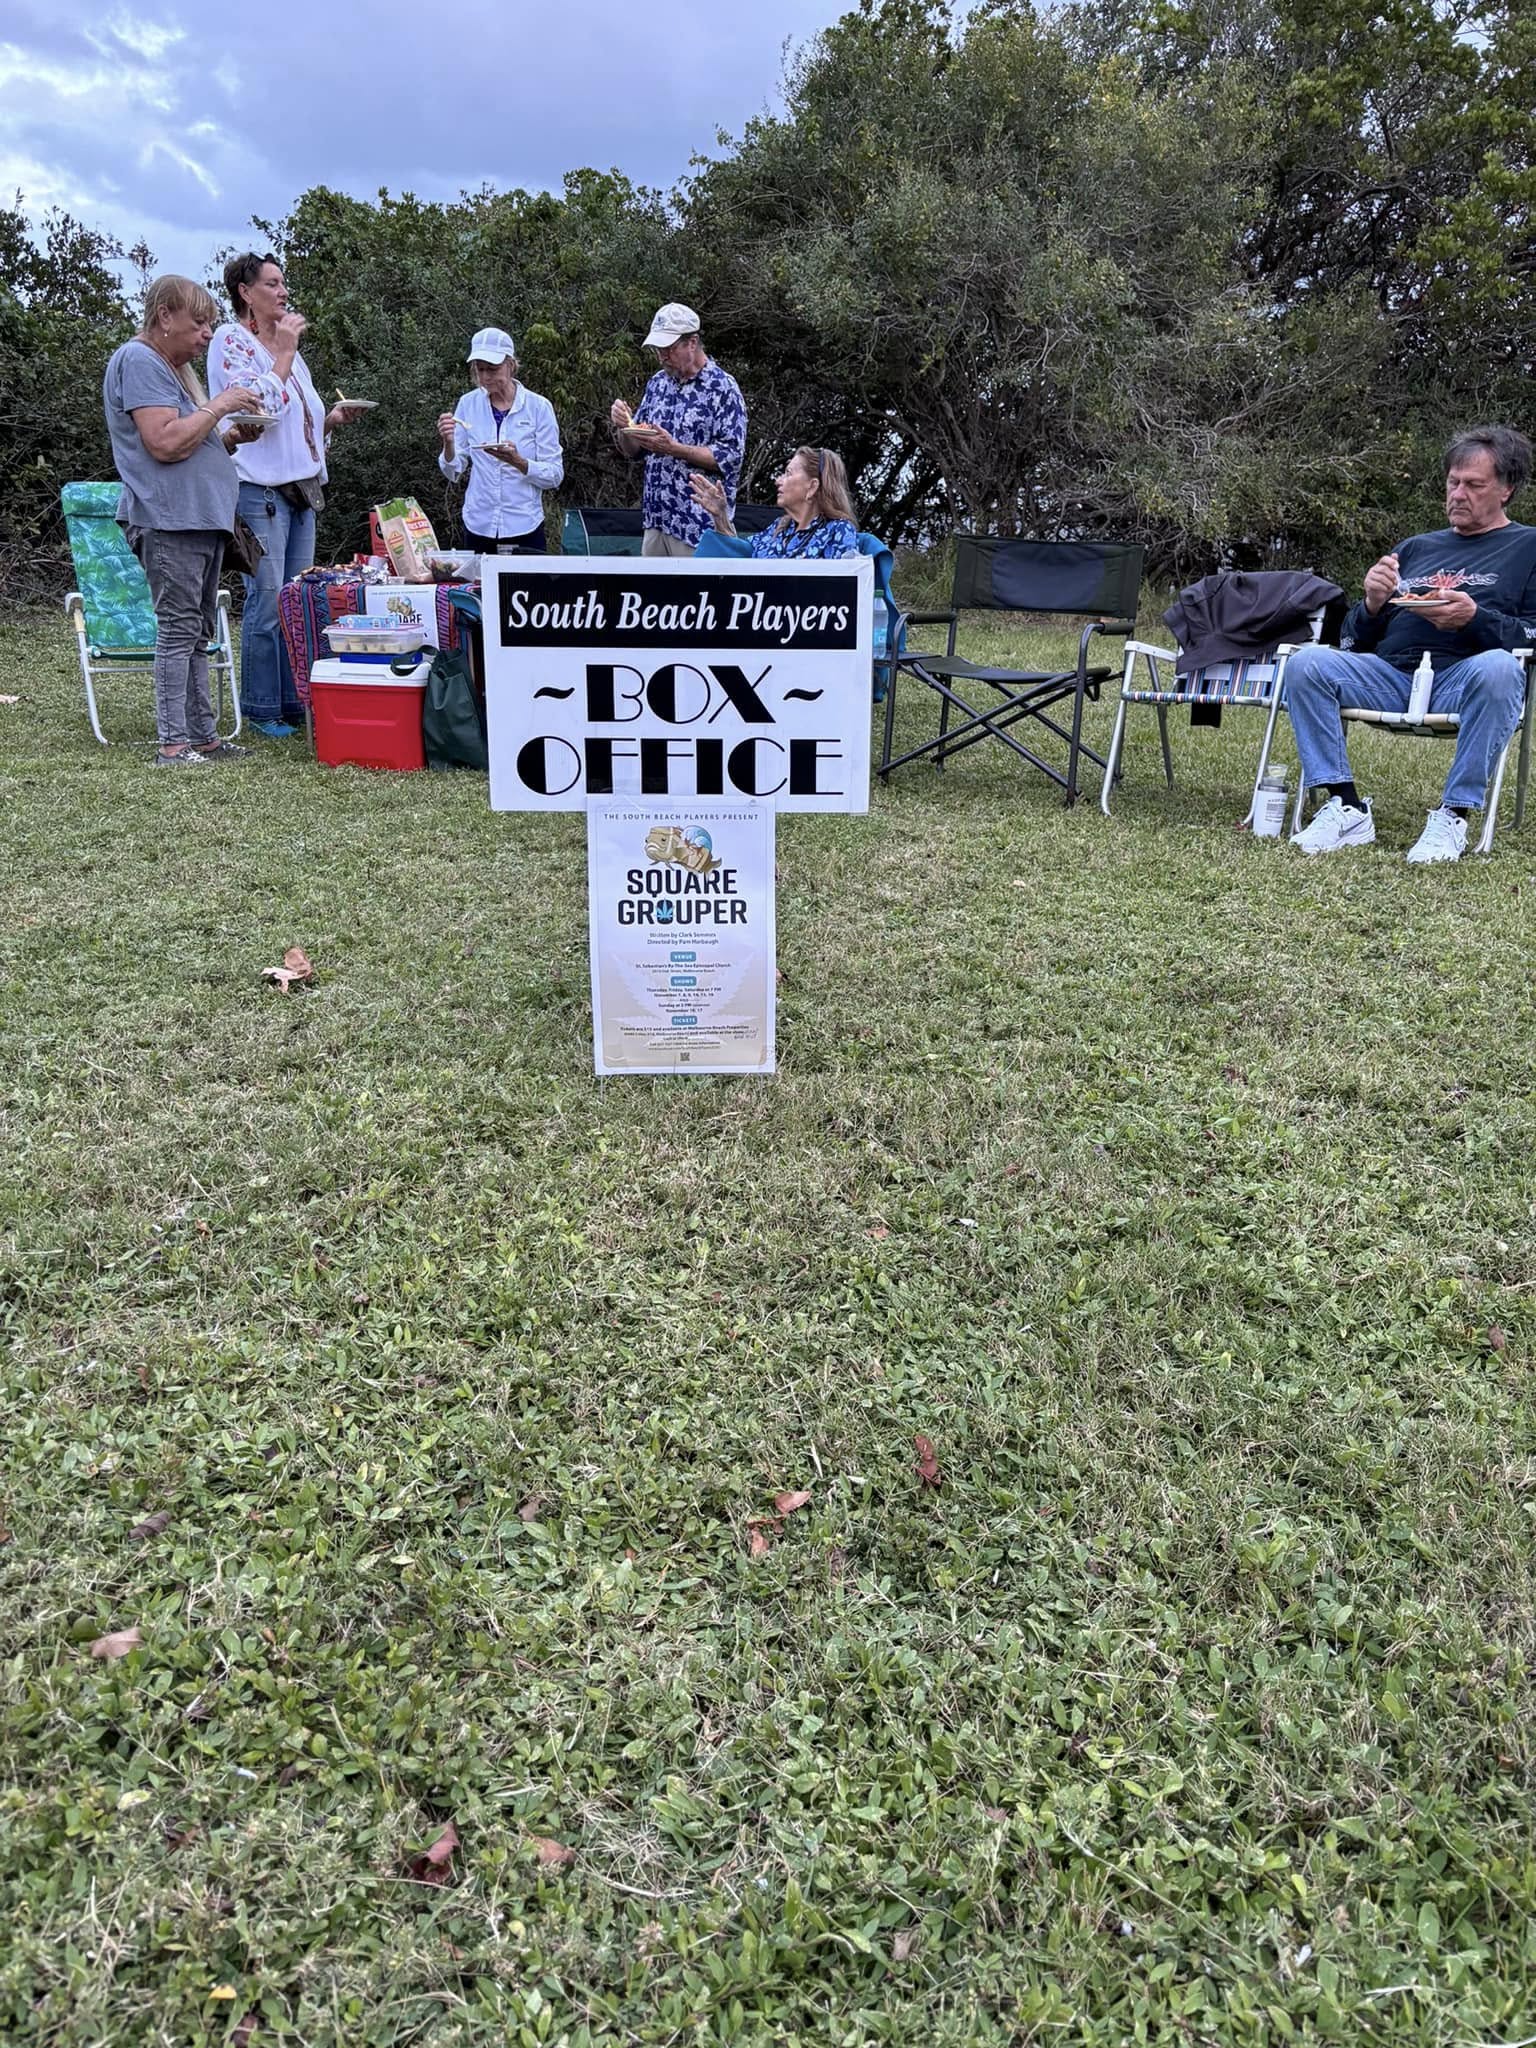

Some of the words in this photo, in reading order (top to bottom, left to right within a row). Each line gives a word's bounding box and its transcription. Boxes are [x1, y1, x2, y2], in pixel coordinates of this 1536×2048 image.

[508, 590, 606, 630] South
[616, 591, 717, 631] Beach
[726, 592, 850, 644] Players
[516, 735, 844, 796] OFFICE
[627, 869, 738, 898] SQUARE
[617, 899, 748, 925] GROUPER
